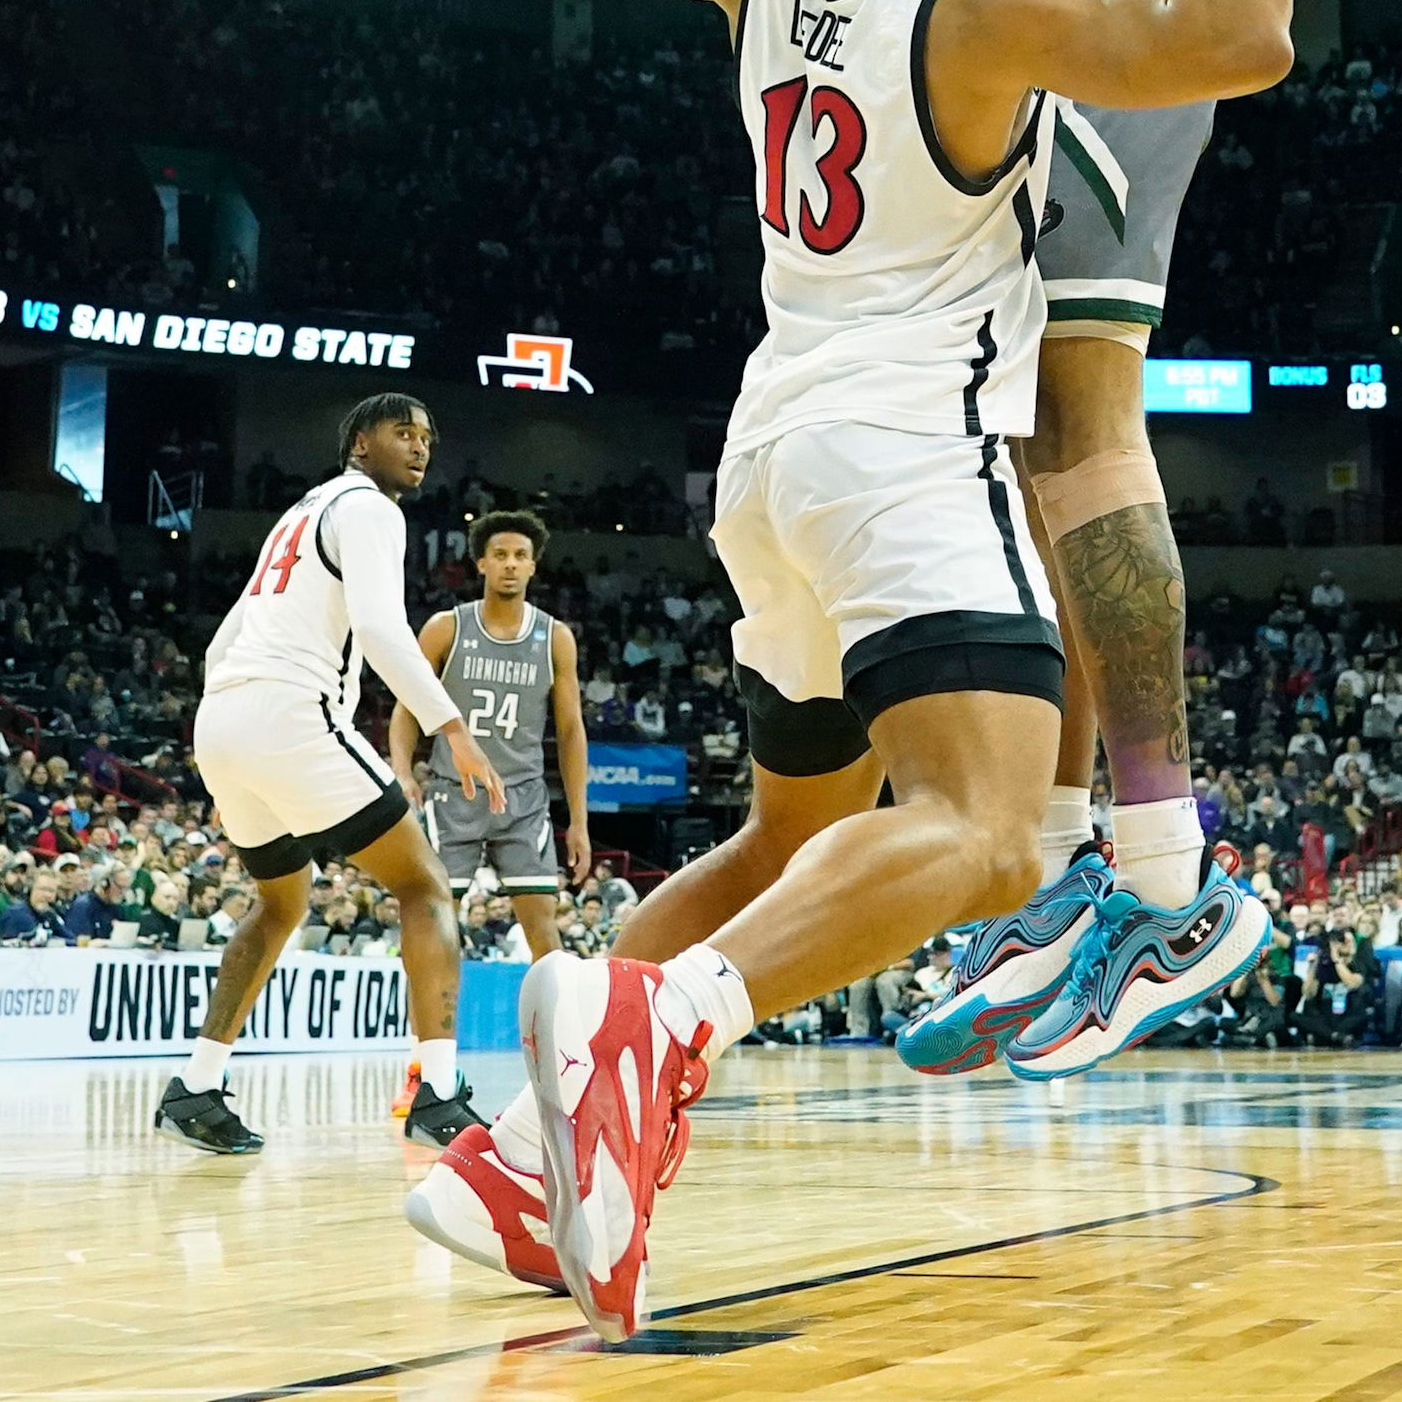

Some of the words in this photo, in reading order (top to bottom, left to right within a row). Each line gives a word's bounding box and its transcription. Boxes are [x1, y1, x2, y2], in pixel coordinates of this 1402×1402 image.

[760, 73, 867, 255] 13
[70, 304, 145, 346] SAN
[153, 314, 285, 358] DIEGO
[292, 325, 415, 369] STATE
[1269, 366, 1328, 386] BONUS
[1351, 364, 1382, 383] FLS
[1347, 382, 1387, 409] 03
[250, 514, 309, 596] 14
[462, 655, 538, 686] BIRMINGHAM
[468, 688, 520, 740] 24
[58, 988, 80, 1015] BY
[89, 962, 298, 1042] UNIVEITY
[308, 968, 345, 1039] OF
[353, 969, 409, 1039] IDA
